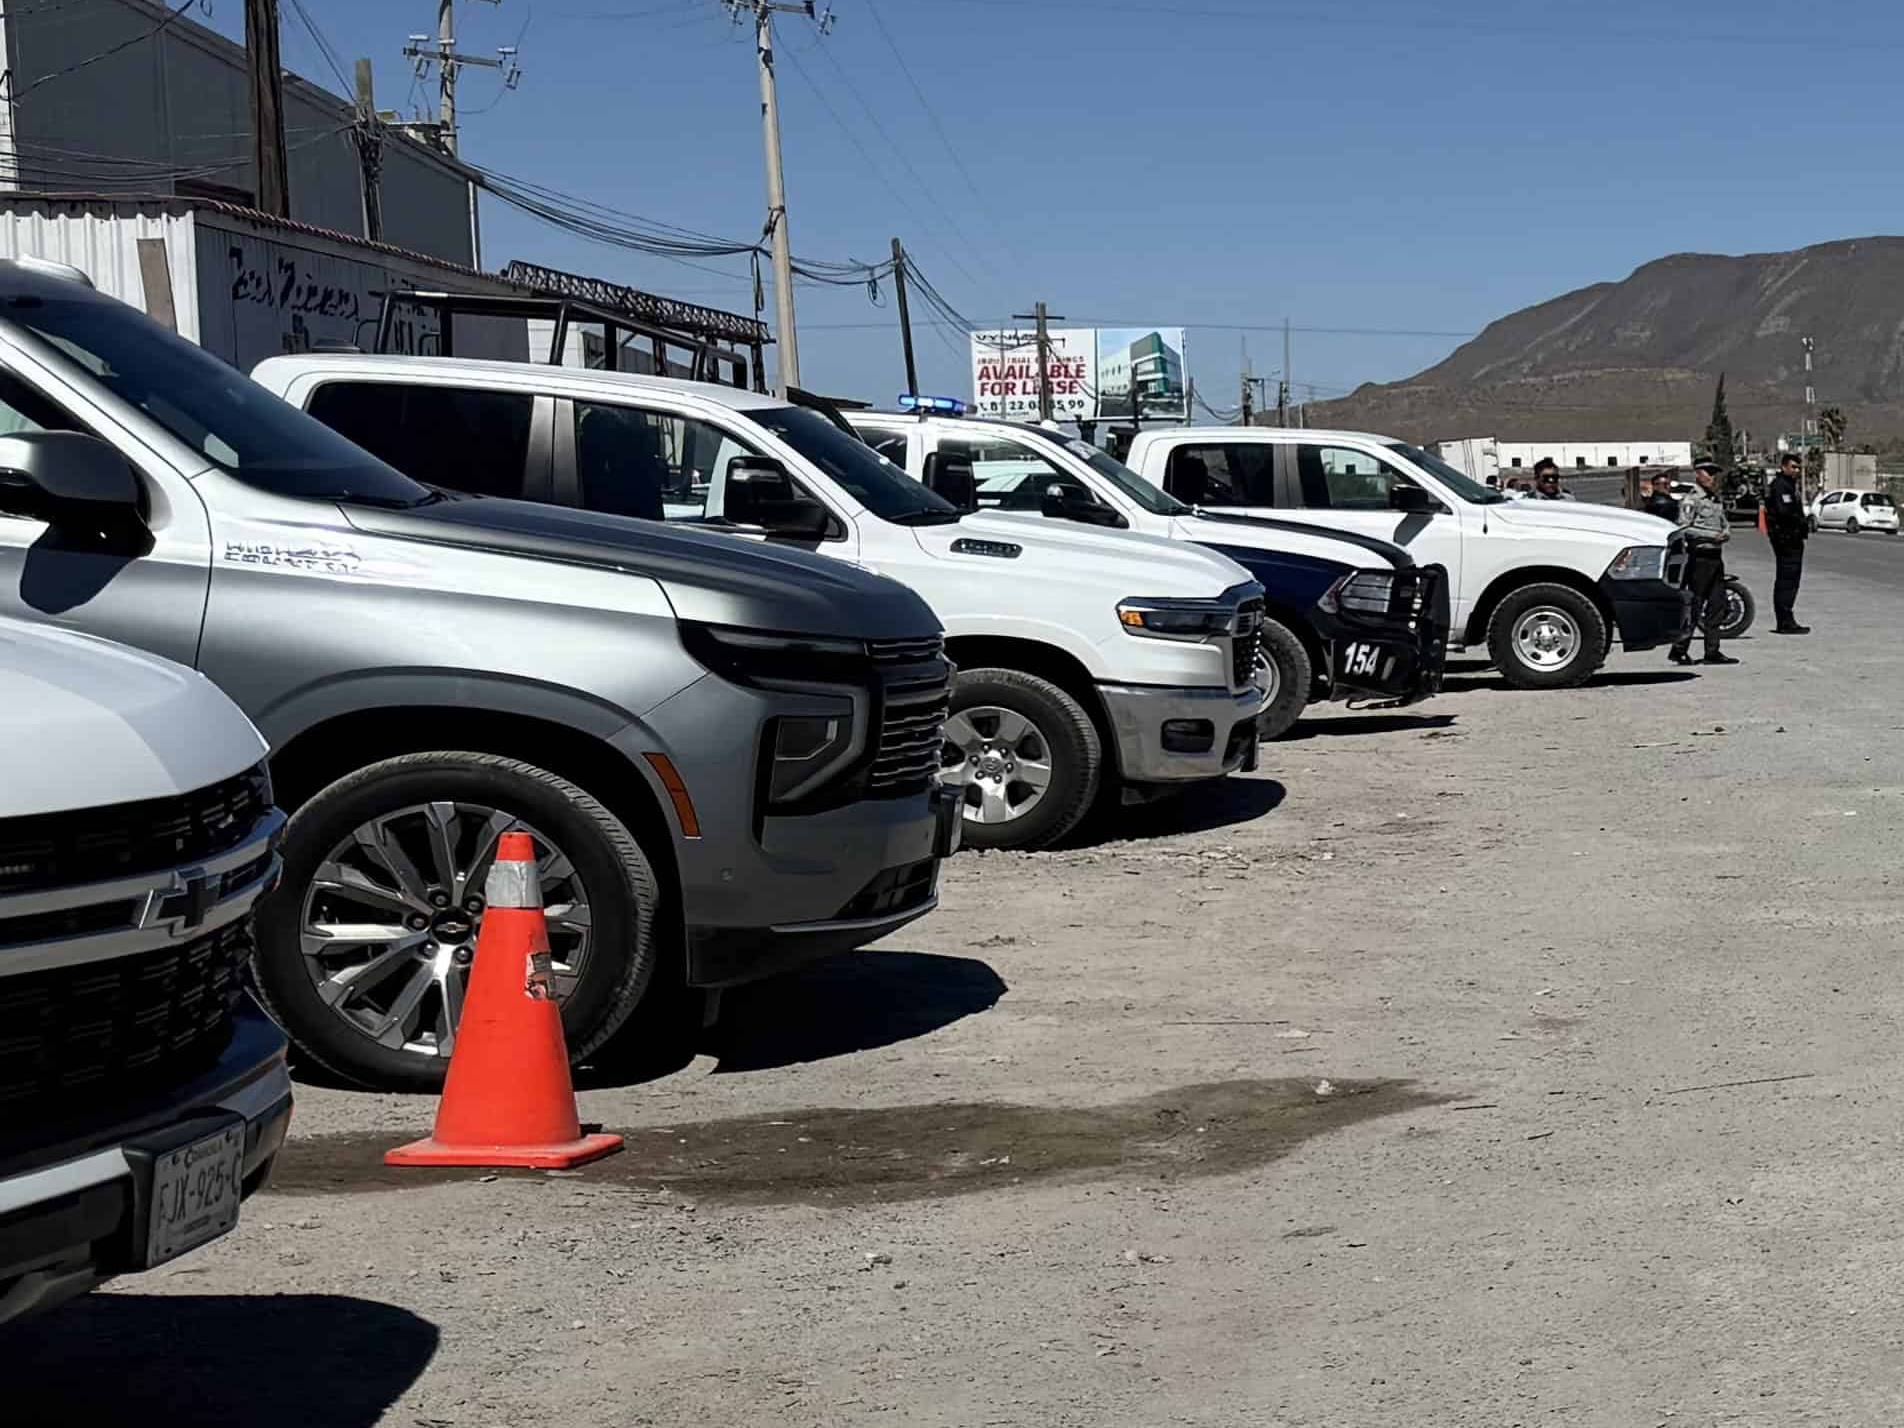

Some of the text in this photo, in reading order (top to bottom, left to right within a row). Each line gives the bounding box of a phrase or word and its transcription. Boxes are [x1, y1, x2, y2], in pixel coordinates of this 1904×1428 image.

[977, 356, 1030, 364] INDUTRIAL
[978, 364, 1086, 380] AVAILBLE
[980, 381, 1016, 396] FOR
[1009, 401, 1024, 410] 22
[1068, 400, 1084, 409] 99
[1344, 641, 1380, 677] 154
